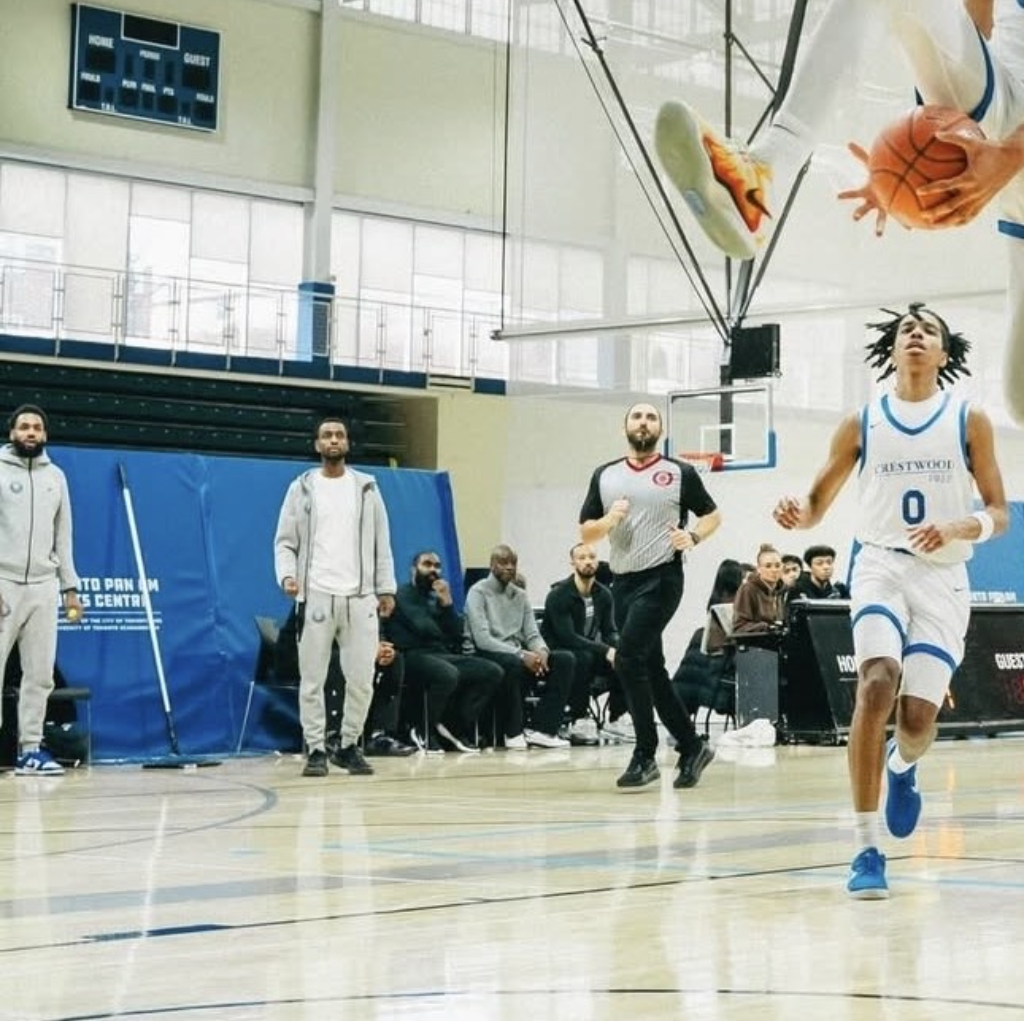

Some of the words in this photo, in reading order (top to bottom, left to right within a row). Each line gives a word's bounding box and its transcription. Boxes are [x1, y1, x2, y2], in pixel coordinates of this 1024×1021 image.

[88, 34, 114, 49] HOME
[183, 52, 211, 67] GUEST
[902, 490, 925, 526] 0
[104, 578, 134, 592] PAN
